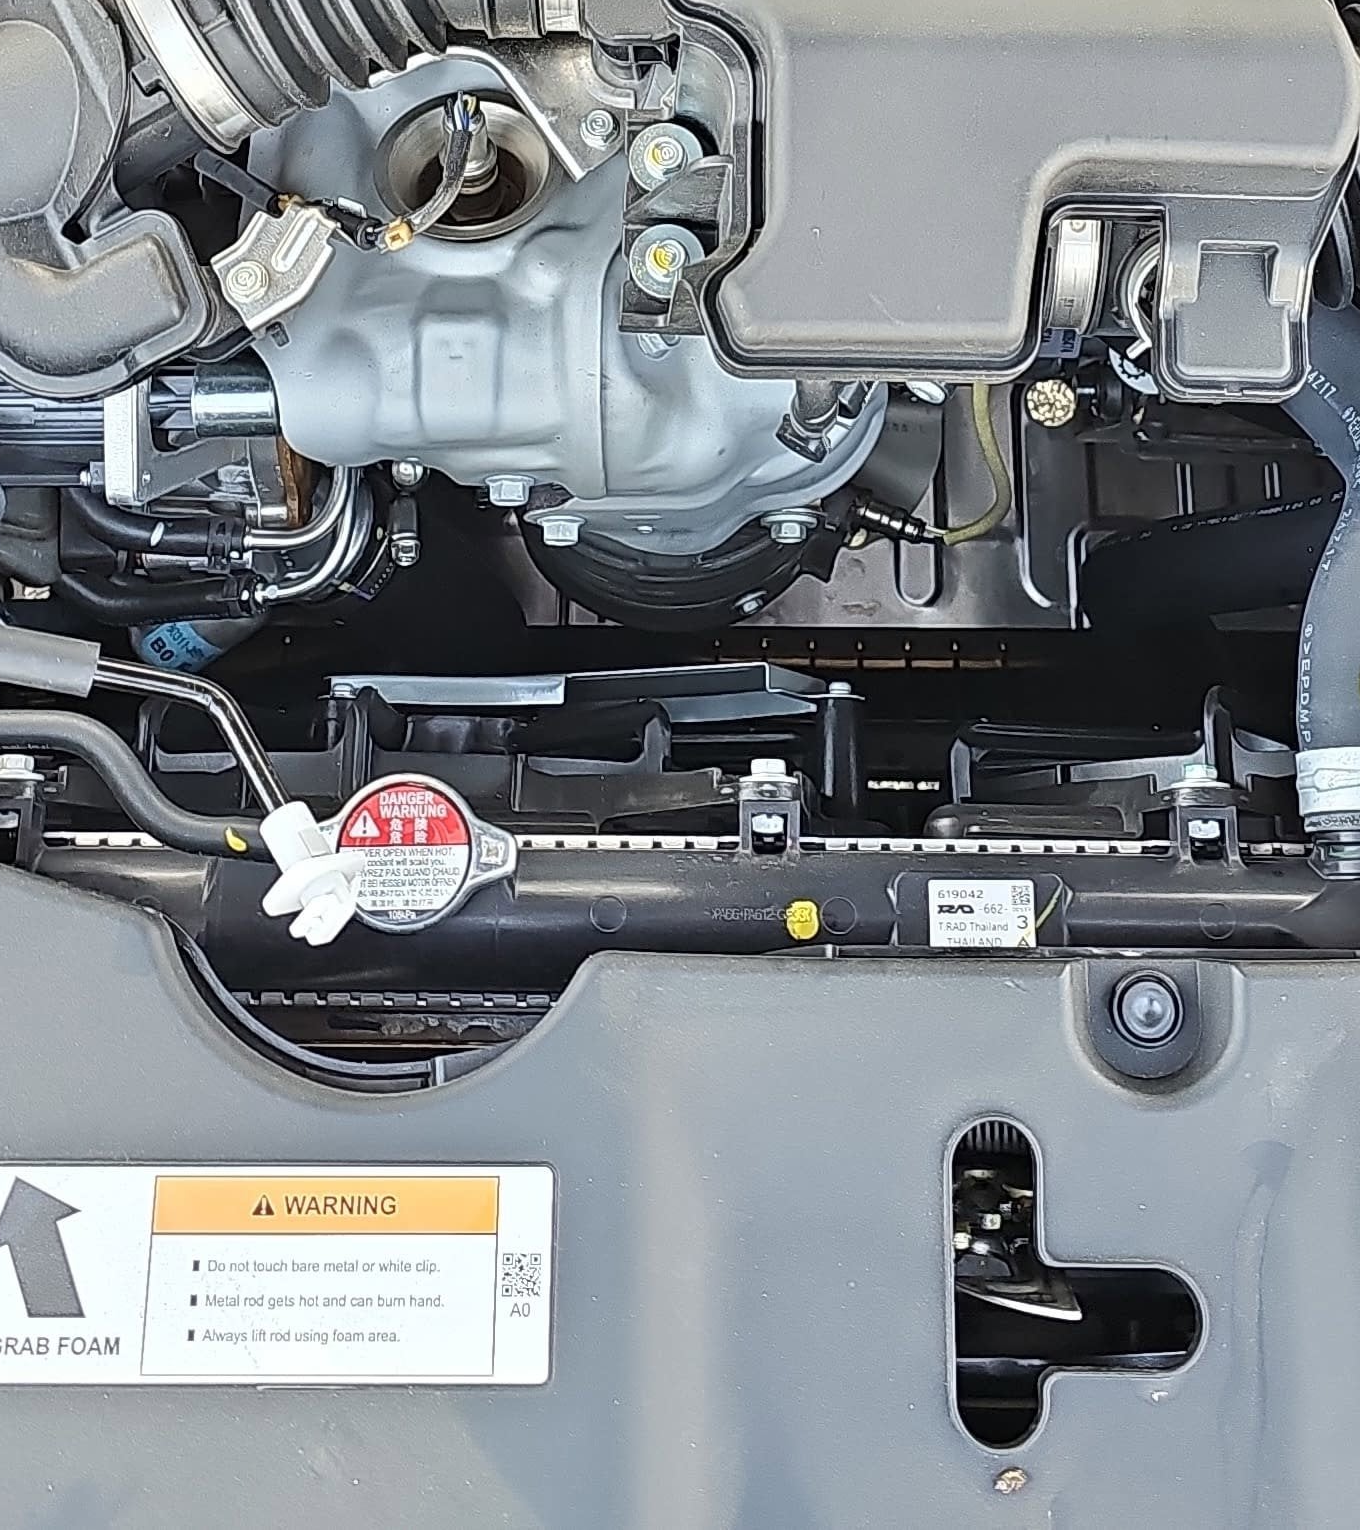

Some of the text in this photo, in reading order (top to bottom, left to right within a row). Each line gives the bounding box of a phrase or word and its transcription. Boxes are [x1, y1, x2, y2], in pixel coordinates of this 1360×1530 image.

[379, 791, 434, 805] DANGER
[380, 804, 447, 819] WARNUNG
[383, 848, 406, 858] OPEN
[408, 847, 433, 857] WHEN
[937, 889, 984, 899] 619042
[969, 921, 1009, 932] Thailand
[1016, 915, 1028, 930] 3
[284, 1195, 397, 1216] WARNING
[207, 1258, 441, 1274] Do not touch bare metal or white clip.
[204, 1294, 445, 1310] Metal rod gets hot and can burn hand.
[509, 1302, 531, 1318] A0
[202, 1329, 401, 1345] Always lift rod using foam area.
[57, 1336, 121, 1356] FOAM
